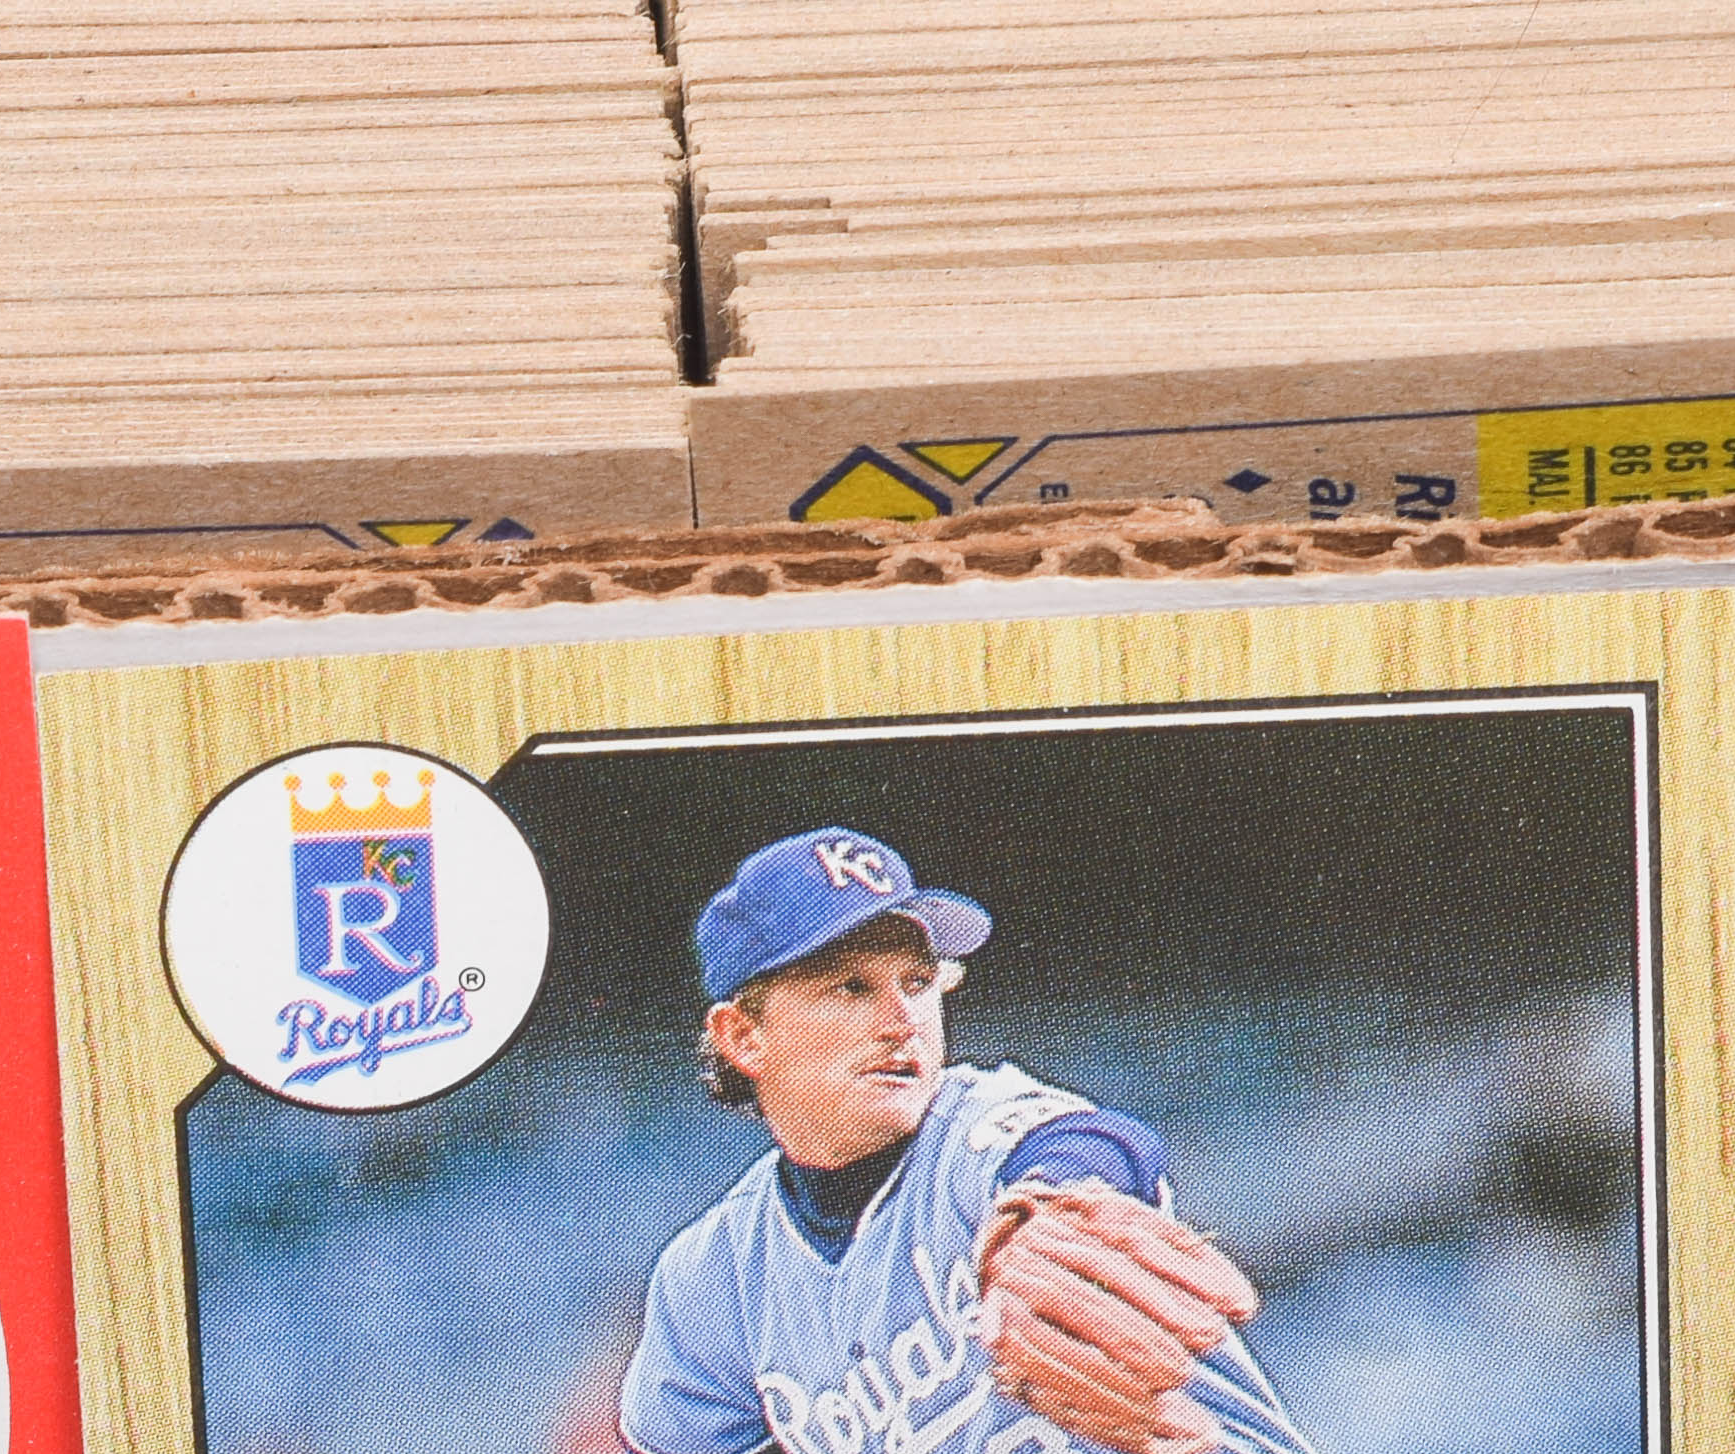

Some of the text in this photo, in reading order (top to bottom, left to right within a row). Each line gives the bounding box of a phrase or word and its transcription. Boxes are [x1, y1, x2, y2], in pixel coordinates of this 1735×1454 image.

[1609, 444, 1652, 475] 86
[1665, 441, 1708, 472] 85
[276, 975, 473, 1087] Royals
